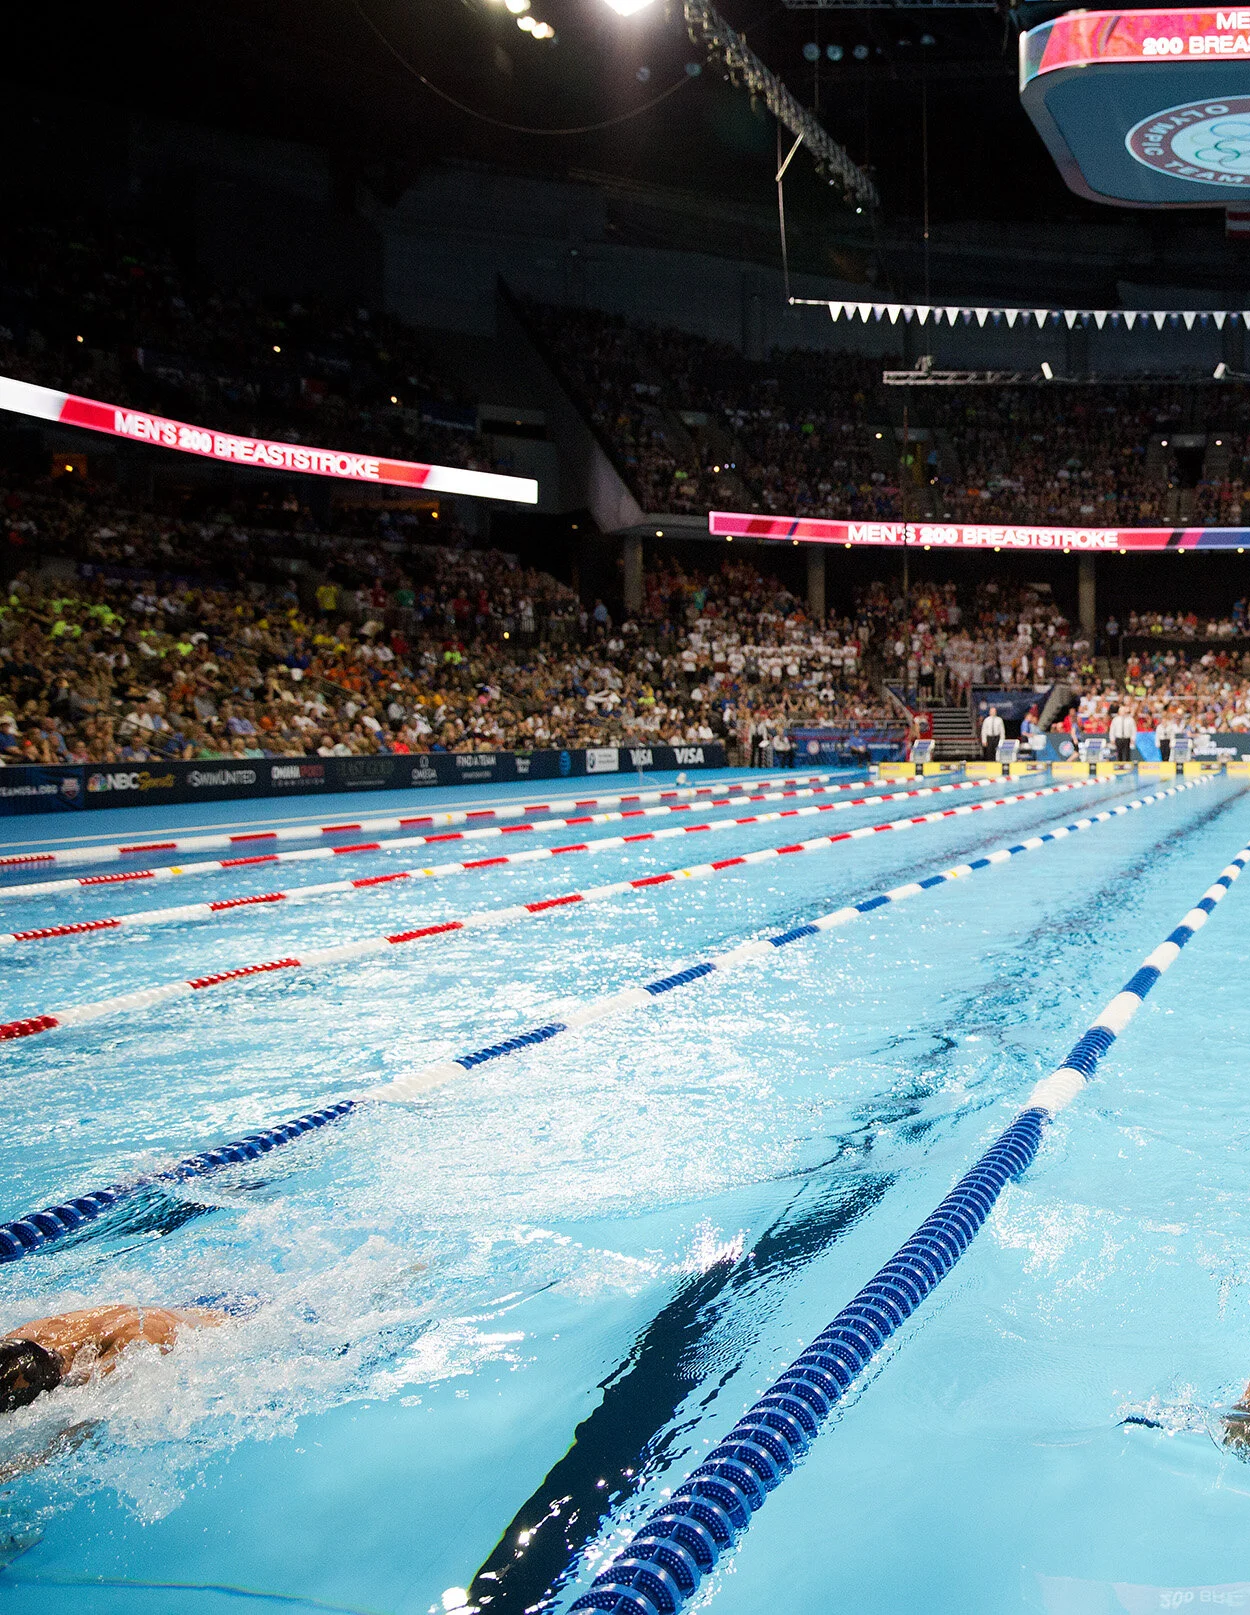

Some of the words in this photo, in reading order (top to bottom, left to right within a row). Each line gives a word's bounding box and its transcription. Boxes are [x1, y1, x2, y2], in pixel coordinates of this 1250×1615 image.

[1142, 37, 1184, 55] 200
[1142, 104, 1230, 156] OLYMPIC
[1164, 160, 1245, 183] TEAM
[115, 410, 177, 445] MEN'S
[178, 427, 213, 453] 200
[214, 435, 380, 478] BREASTSTROKE
[848, 524, 916, 544] MEN'S
[919, 526, 959, 544] 200
[962, 528, 1118, 548] BREASTSTROKE
[630, 749, 653, 766] VISA
[674, 748, 704, 764] VISA
[107, 772, 139, 790] NBC
